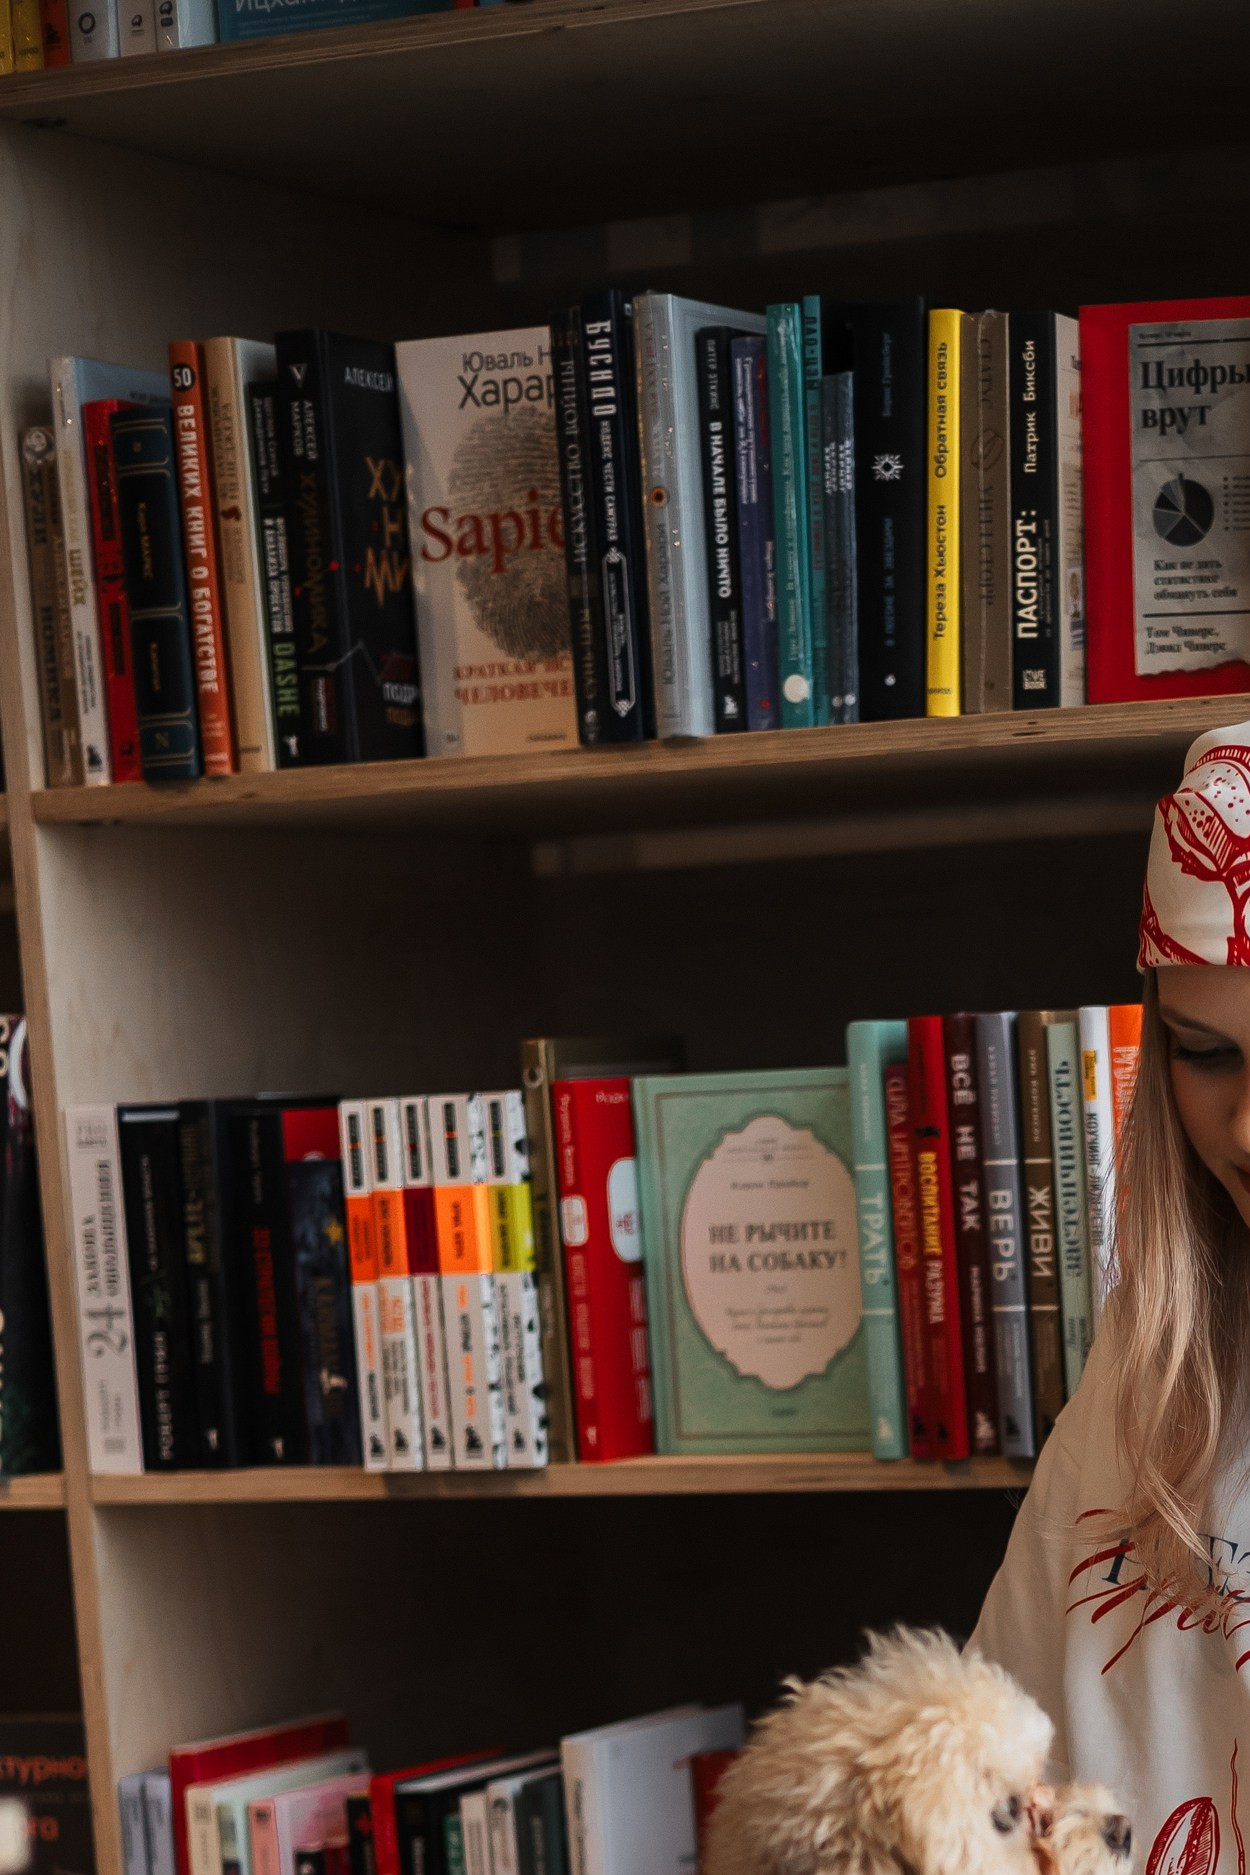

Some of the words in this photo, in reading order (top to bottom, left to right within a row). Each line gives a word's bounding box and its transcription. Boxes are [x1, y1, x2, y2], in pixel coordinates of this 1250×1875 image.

[173, 367, 193, 389] 50
[463, 350, 535, 374] Юваль
[935, 342, 948, 390] связь
[1022, 340, 1037, 401] Биксби
[557, 360, 581, 435] ВОЙНЫ
[1140, 404, 1211, 437] врут
[177, 405, 203, 498] ВЕЛИКИХ
[302, 401, 318, 461] АЛЕКСЕЙ
[933, 394, 950, 478] Обратная
[1024, 412, 1039, 473] Патрик
[709, 435, 727, 495] НАЧАЛЕ
[187, 506, 208, 559] КНИГ
[565, 444, 589, 562] ИСКУССТВО
[712, 498, 729, 543] БЫЛО
[933, 505, 946, 578] Хьюстон
[192, 566, 208, 578] О
[714, 547, 732, 599] НИЧТО
[1016, 508, 1039, 639] ПАСПОРТ:
[193, 587, 218, 693] БОГАТСТВЕ
[933, 583, 946, 639] Тереза
[272, 642, 299, 717] DASHE
[951, 1054, 975, 1105] ВСЁ
[957, 1126, 975, 1161] НЕ
[708, 1224, 739, 1246] НЕ
[745, 1220, 838, 1243] РЫЧИТЕ
[917, 1151, 942, 1256] ВОСПИТАНИЕ
[960, 1181, 980, 1231] ТАК
[1028, 1186, 1053, 1278] ЖИВИ
[709, 1252, 742, 1274] НА
[924, 1260, 944, 1324] РАЗУМА
